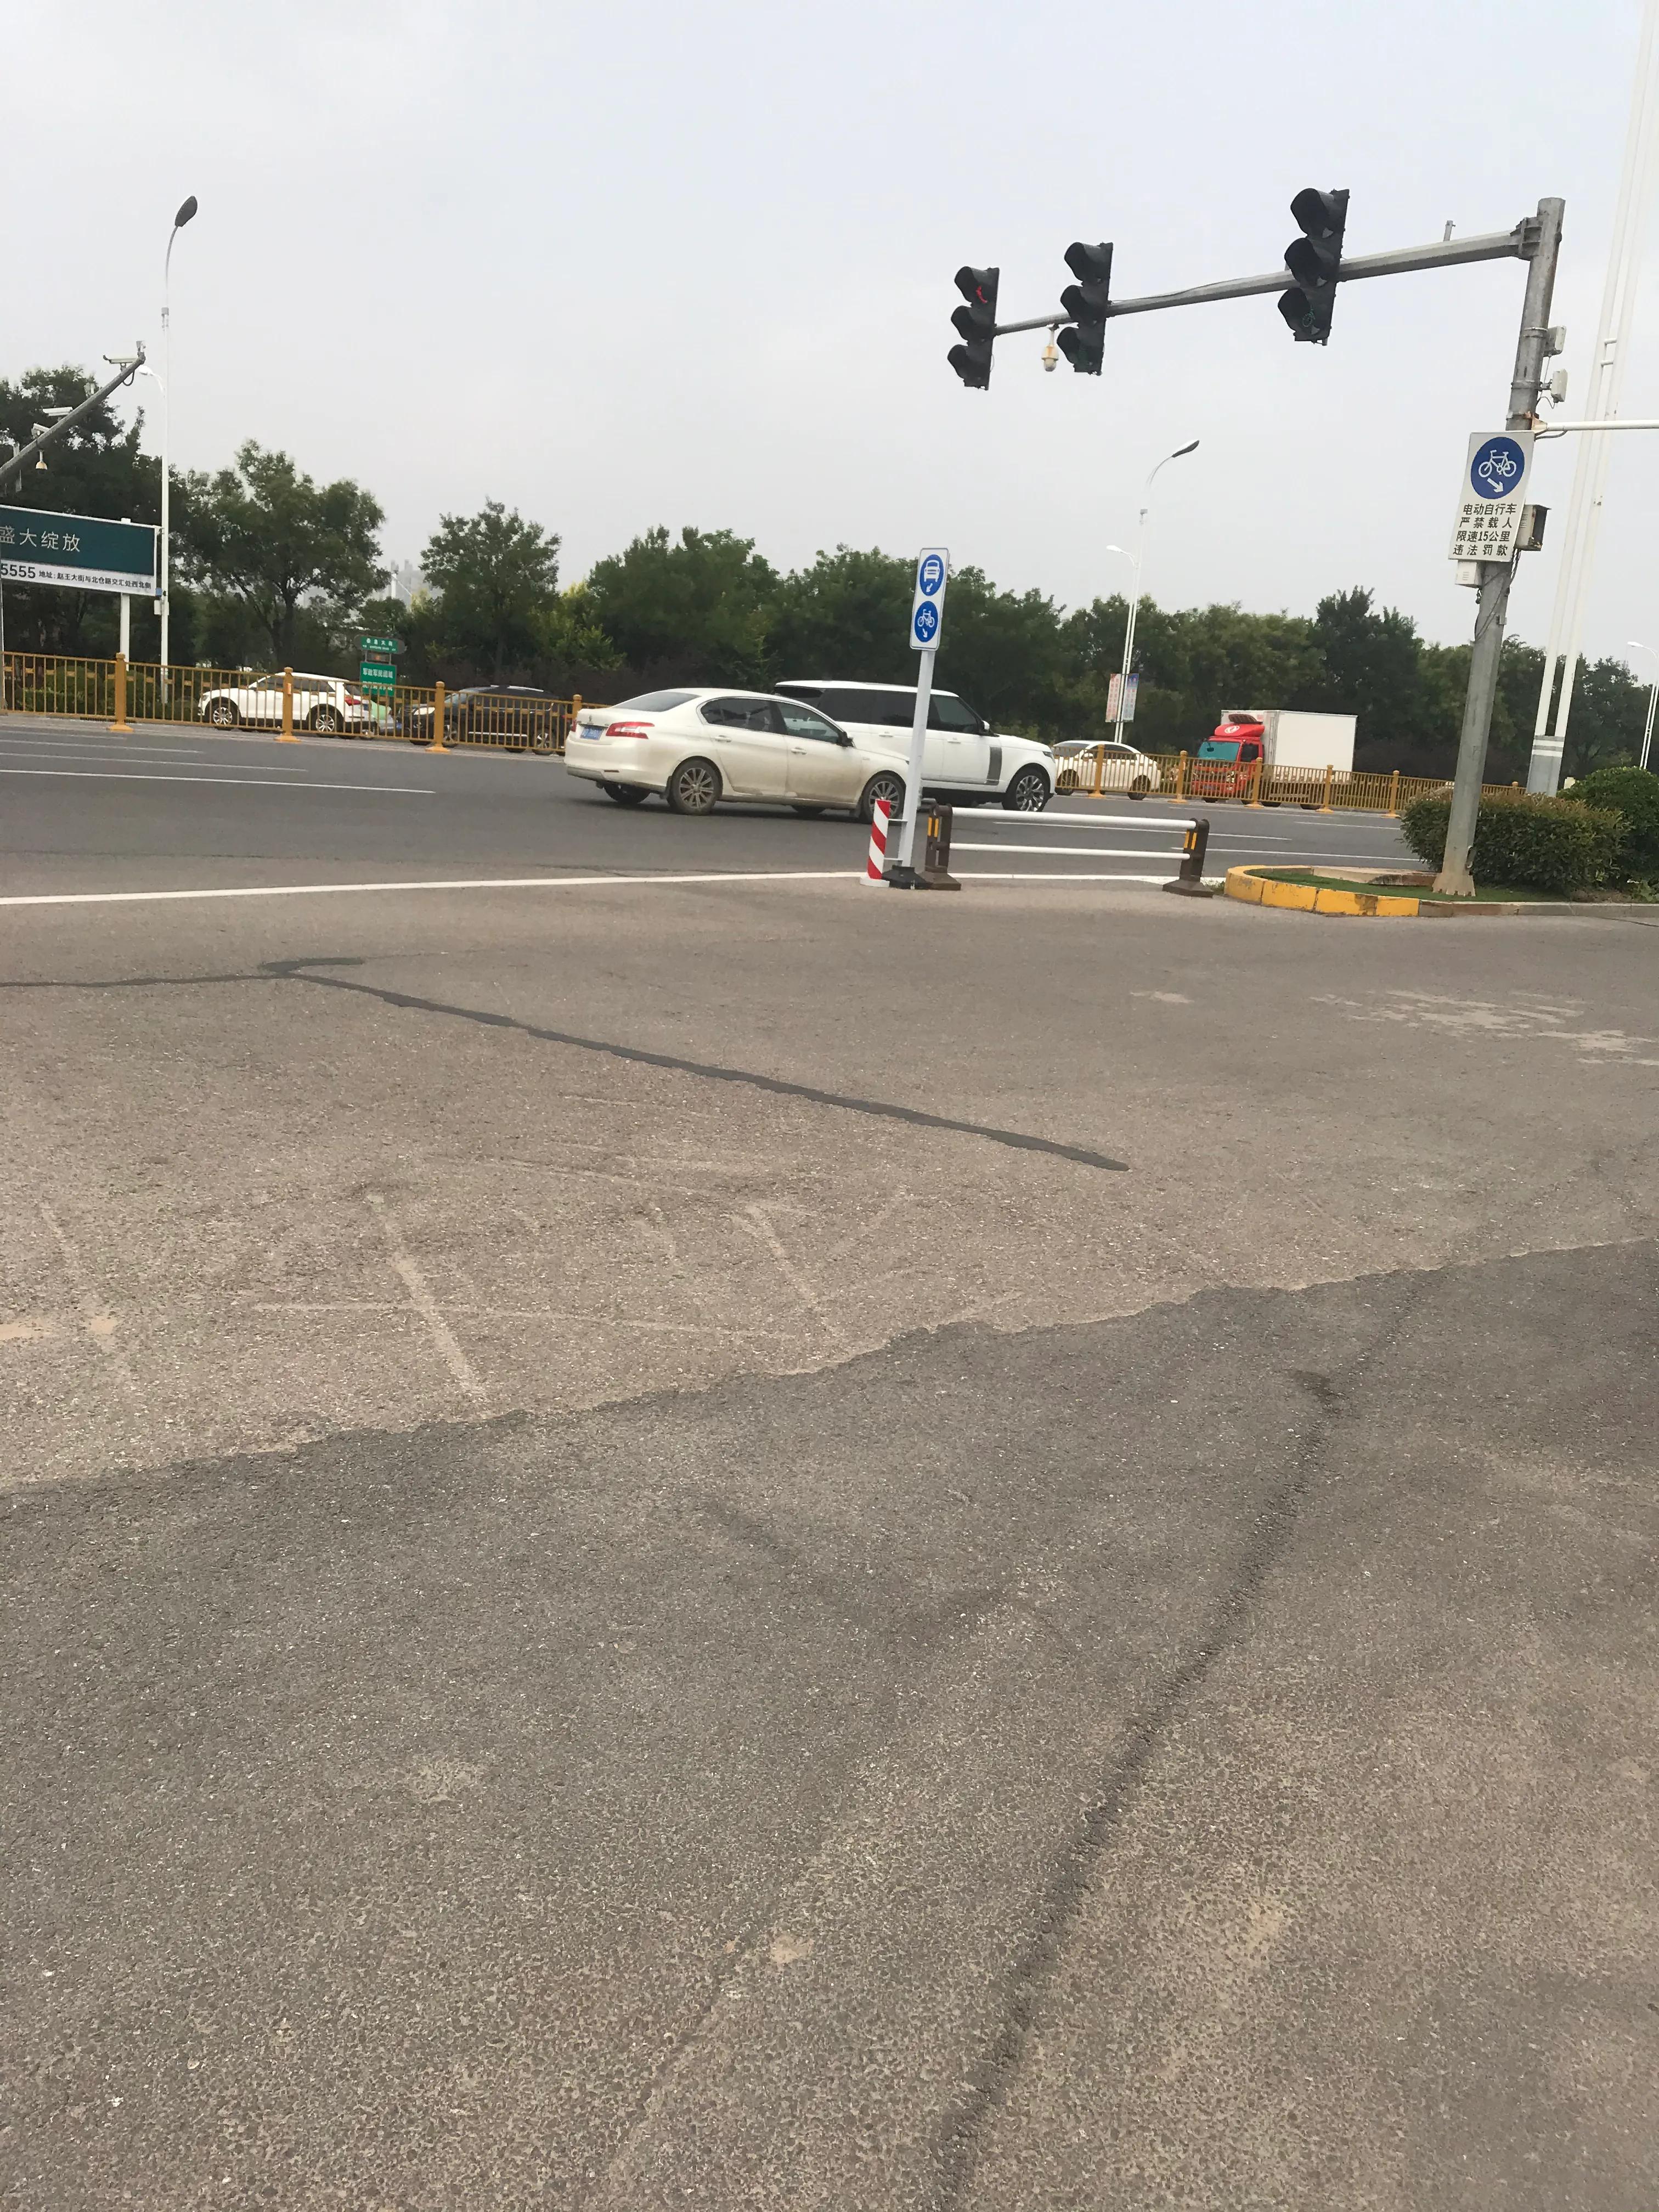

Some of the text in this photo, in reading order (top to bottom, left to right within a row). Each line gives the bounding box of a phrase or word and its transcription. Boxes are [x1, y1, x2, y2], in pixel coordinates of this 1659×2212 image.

[1463, 503, 1517, 515] 电动自行车
[1459, 517, 1513, 528] 严禁载人
[0, 525, 80, 552] 盛大绽放
[1457, 531, 1510, 542] 限速15公里
[1453, 544, 1508, 556] 违法罚款
